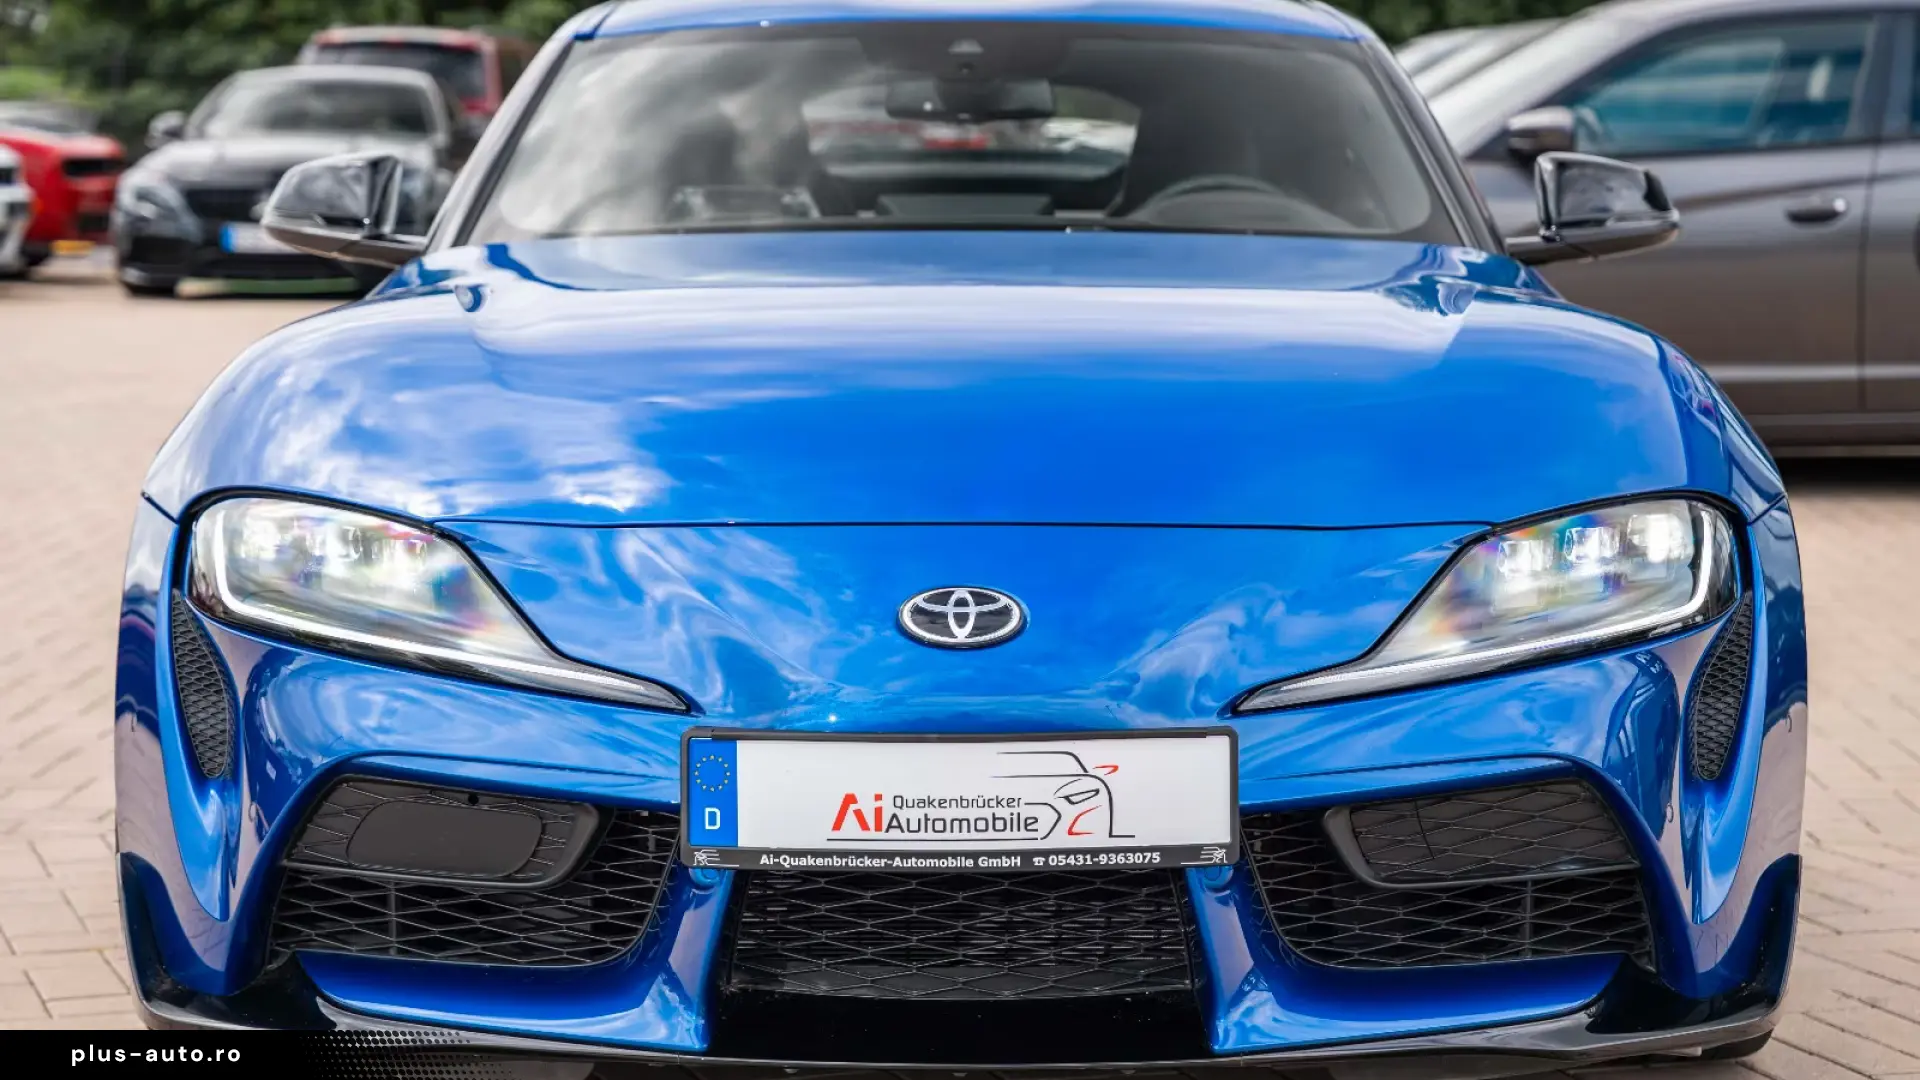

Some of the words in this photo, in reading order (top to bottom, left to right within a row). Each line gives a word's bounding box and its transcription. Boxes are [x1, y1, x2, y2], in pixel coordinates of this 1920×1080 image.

[831, 792, 883, 832] Ai
[893, 795, 1022, 810] Quakenbrücker
[704, 807, 721, 830] D
[884, 812, 1039, 834] Automobile
[759, 854, 974, 869] Ai-Quakenbrücker-Automobile
[978, 855, 1022, 868] GmbH
[1048, 852, 1161, 867] 05431-9363075
